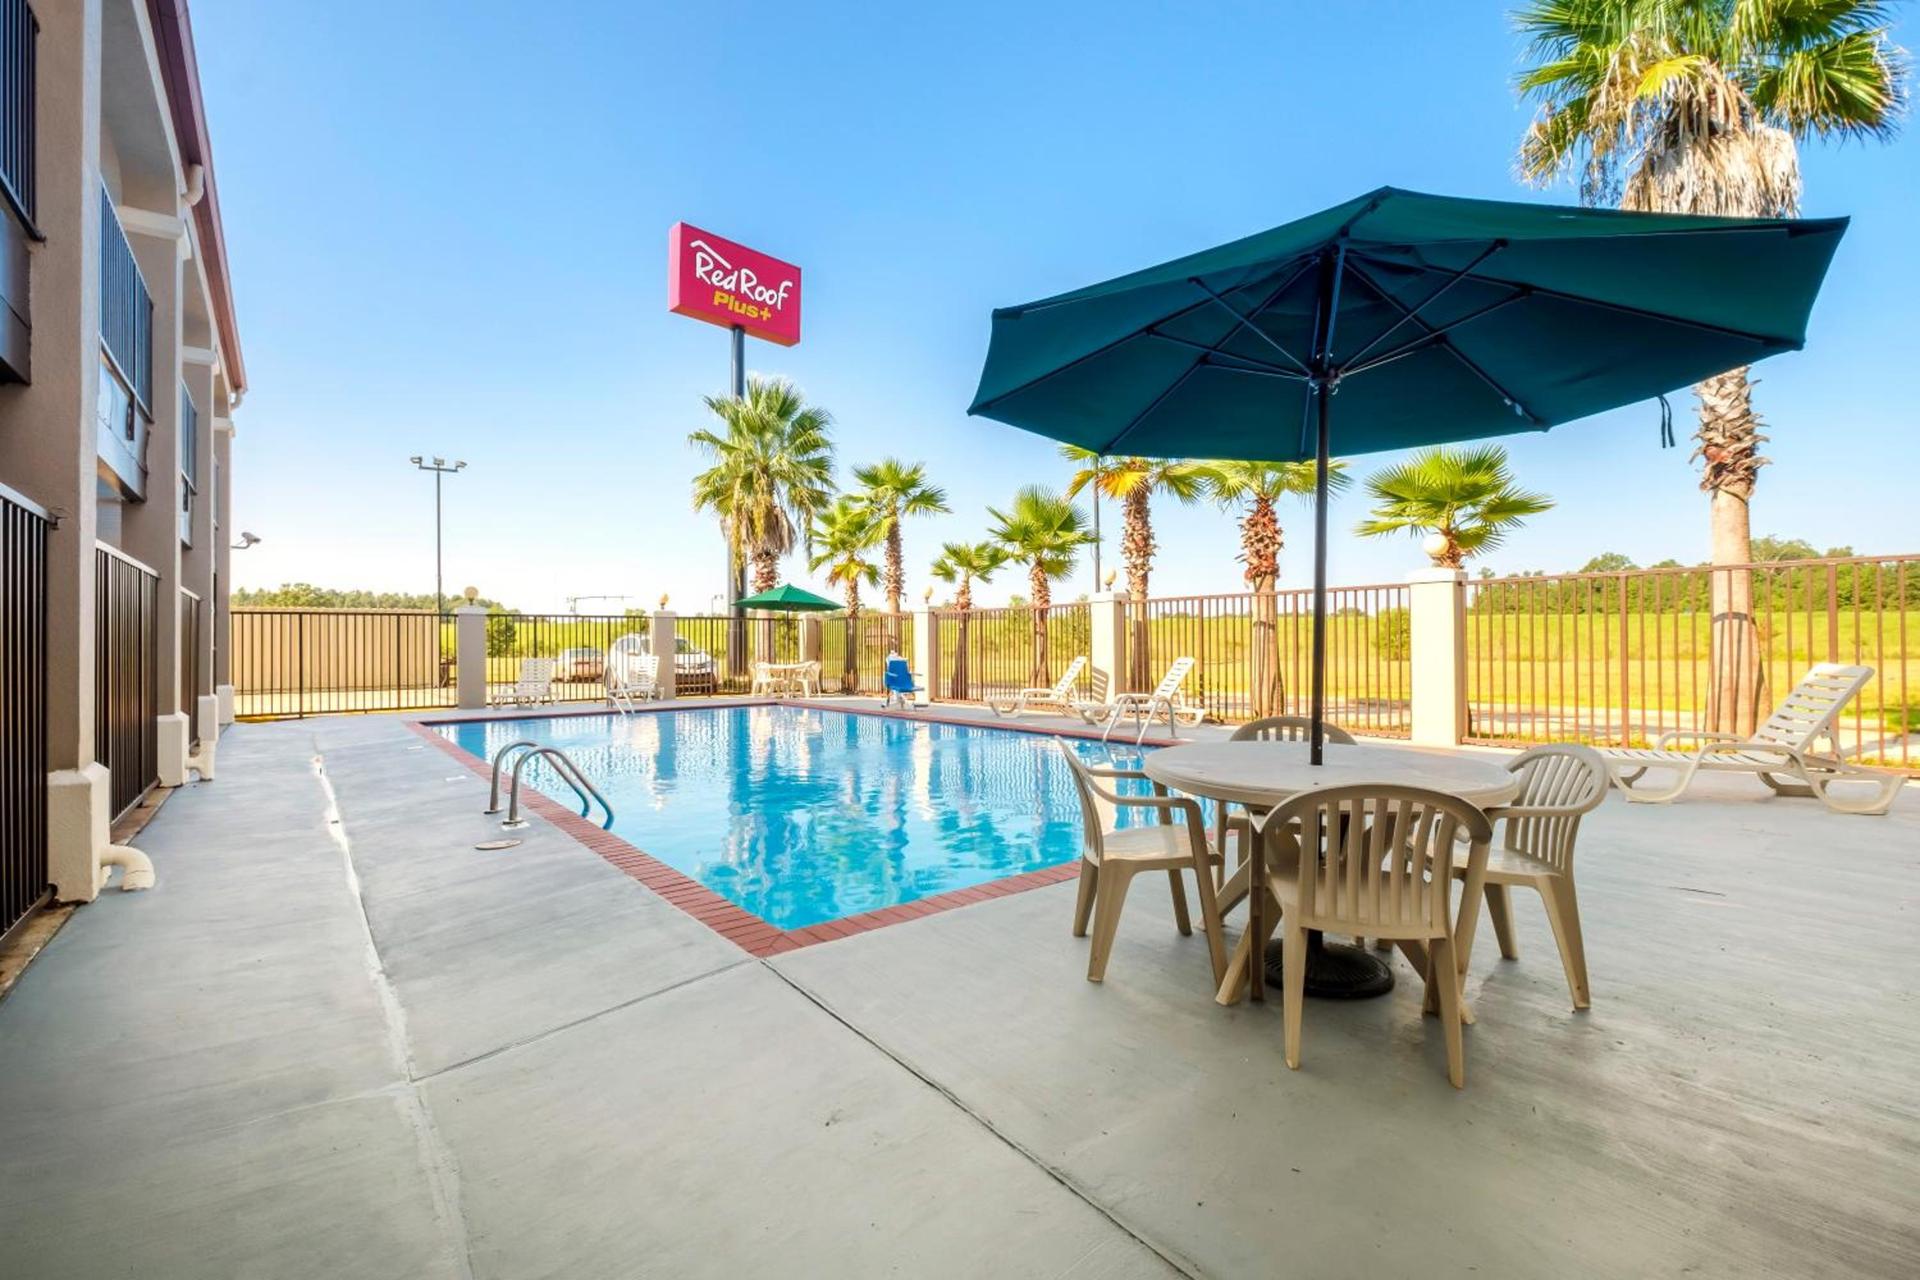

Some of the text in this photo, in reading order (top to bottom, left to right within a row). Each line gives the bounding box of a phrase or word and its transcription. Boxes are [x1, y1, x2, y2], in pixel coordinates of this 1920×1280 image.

[696, 251, 793, 310] Red Roof
[713, 290, 772, 321] Plus+
